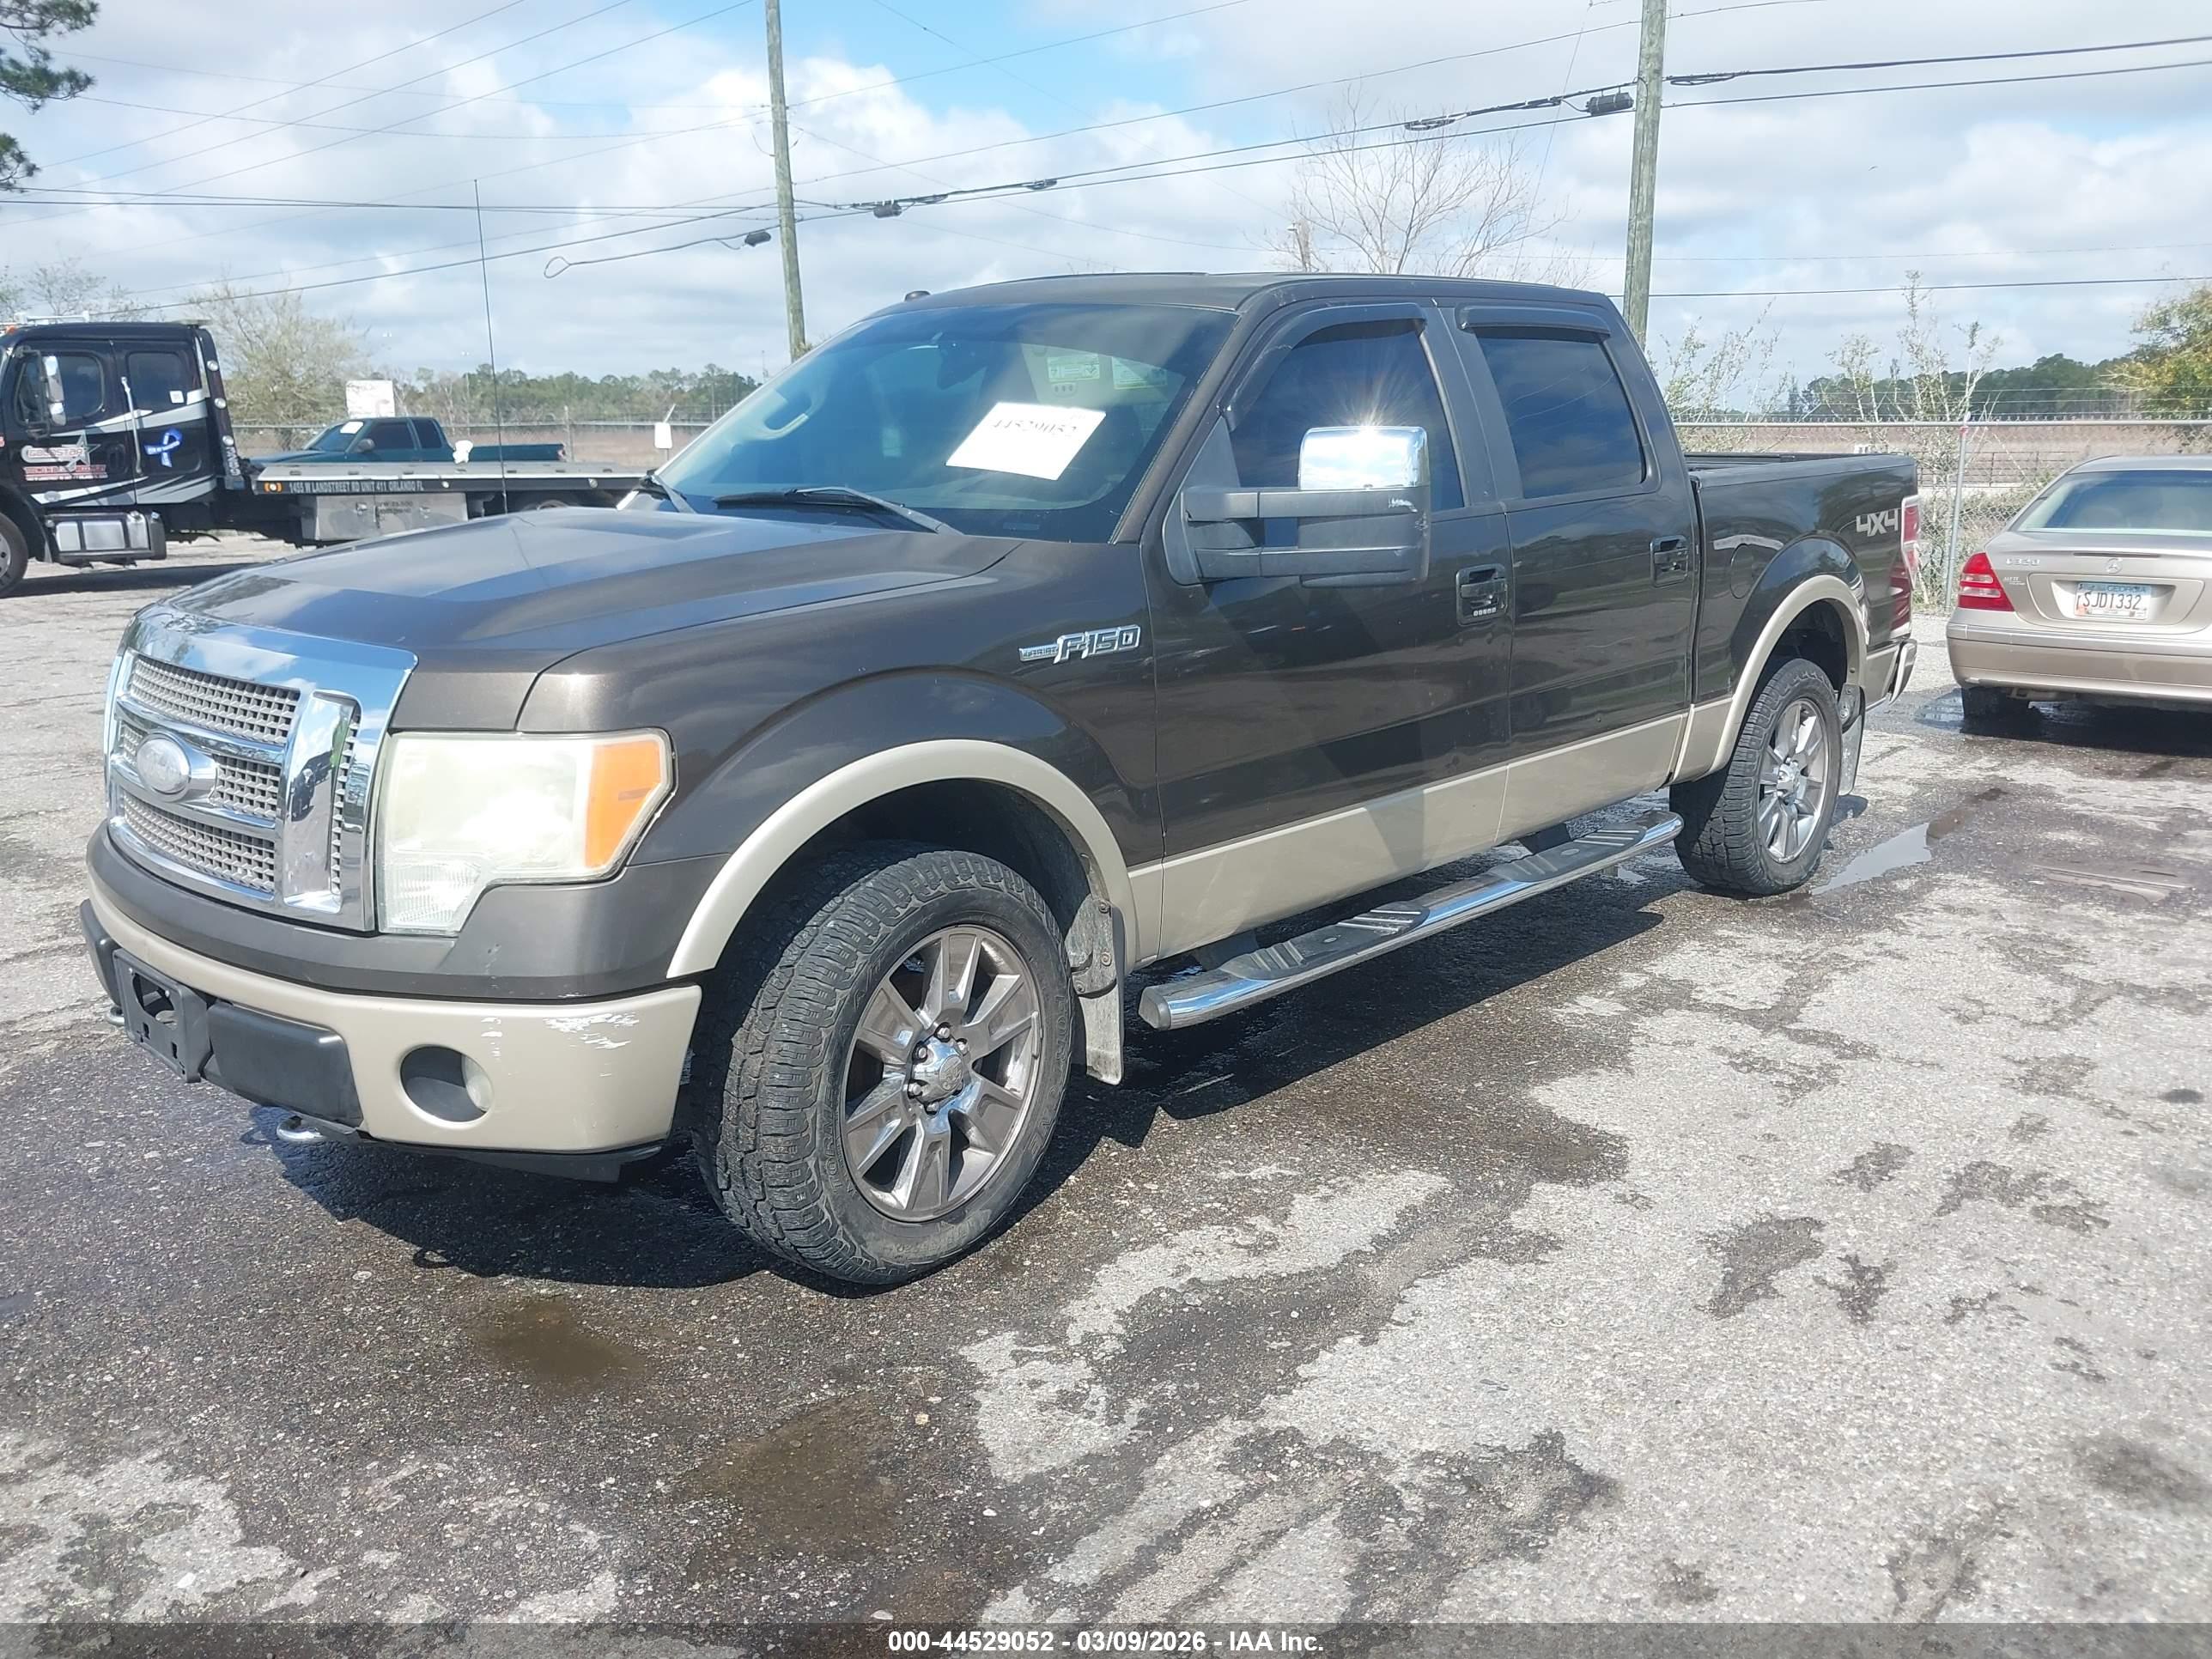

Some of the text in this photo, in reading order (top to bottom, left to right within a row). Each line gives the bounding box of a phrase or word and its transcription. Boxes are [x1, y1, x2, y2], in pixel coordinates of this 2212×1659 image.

[304, 482, 311, 493] W
[351, 481, 360, 492] RD
[361, 481, 375, 492] UNIT
[416, 480, 424, 491] FL
[2082, 591, 2142, 611] SJD1332
